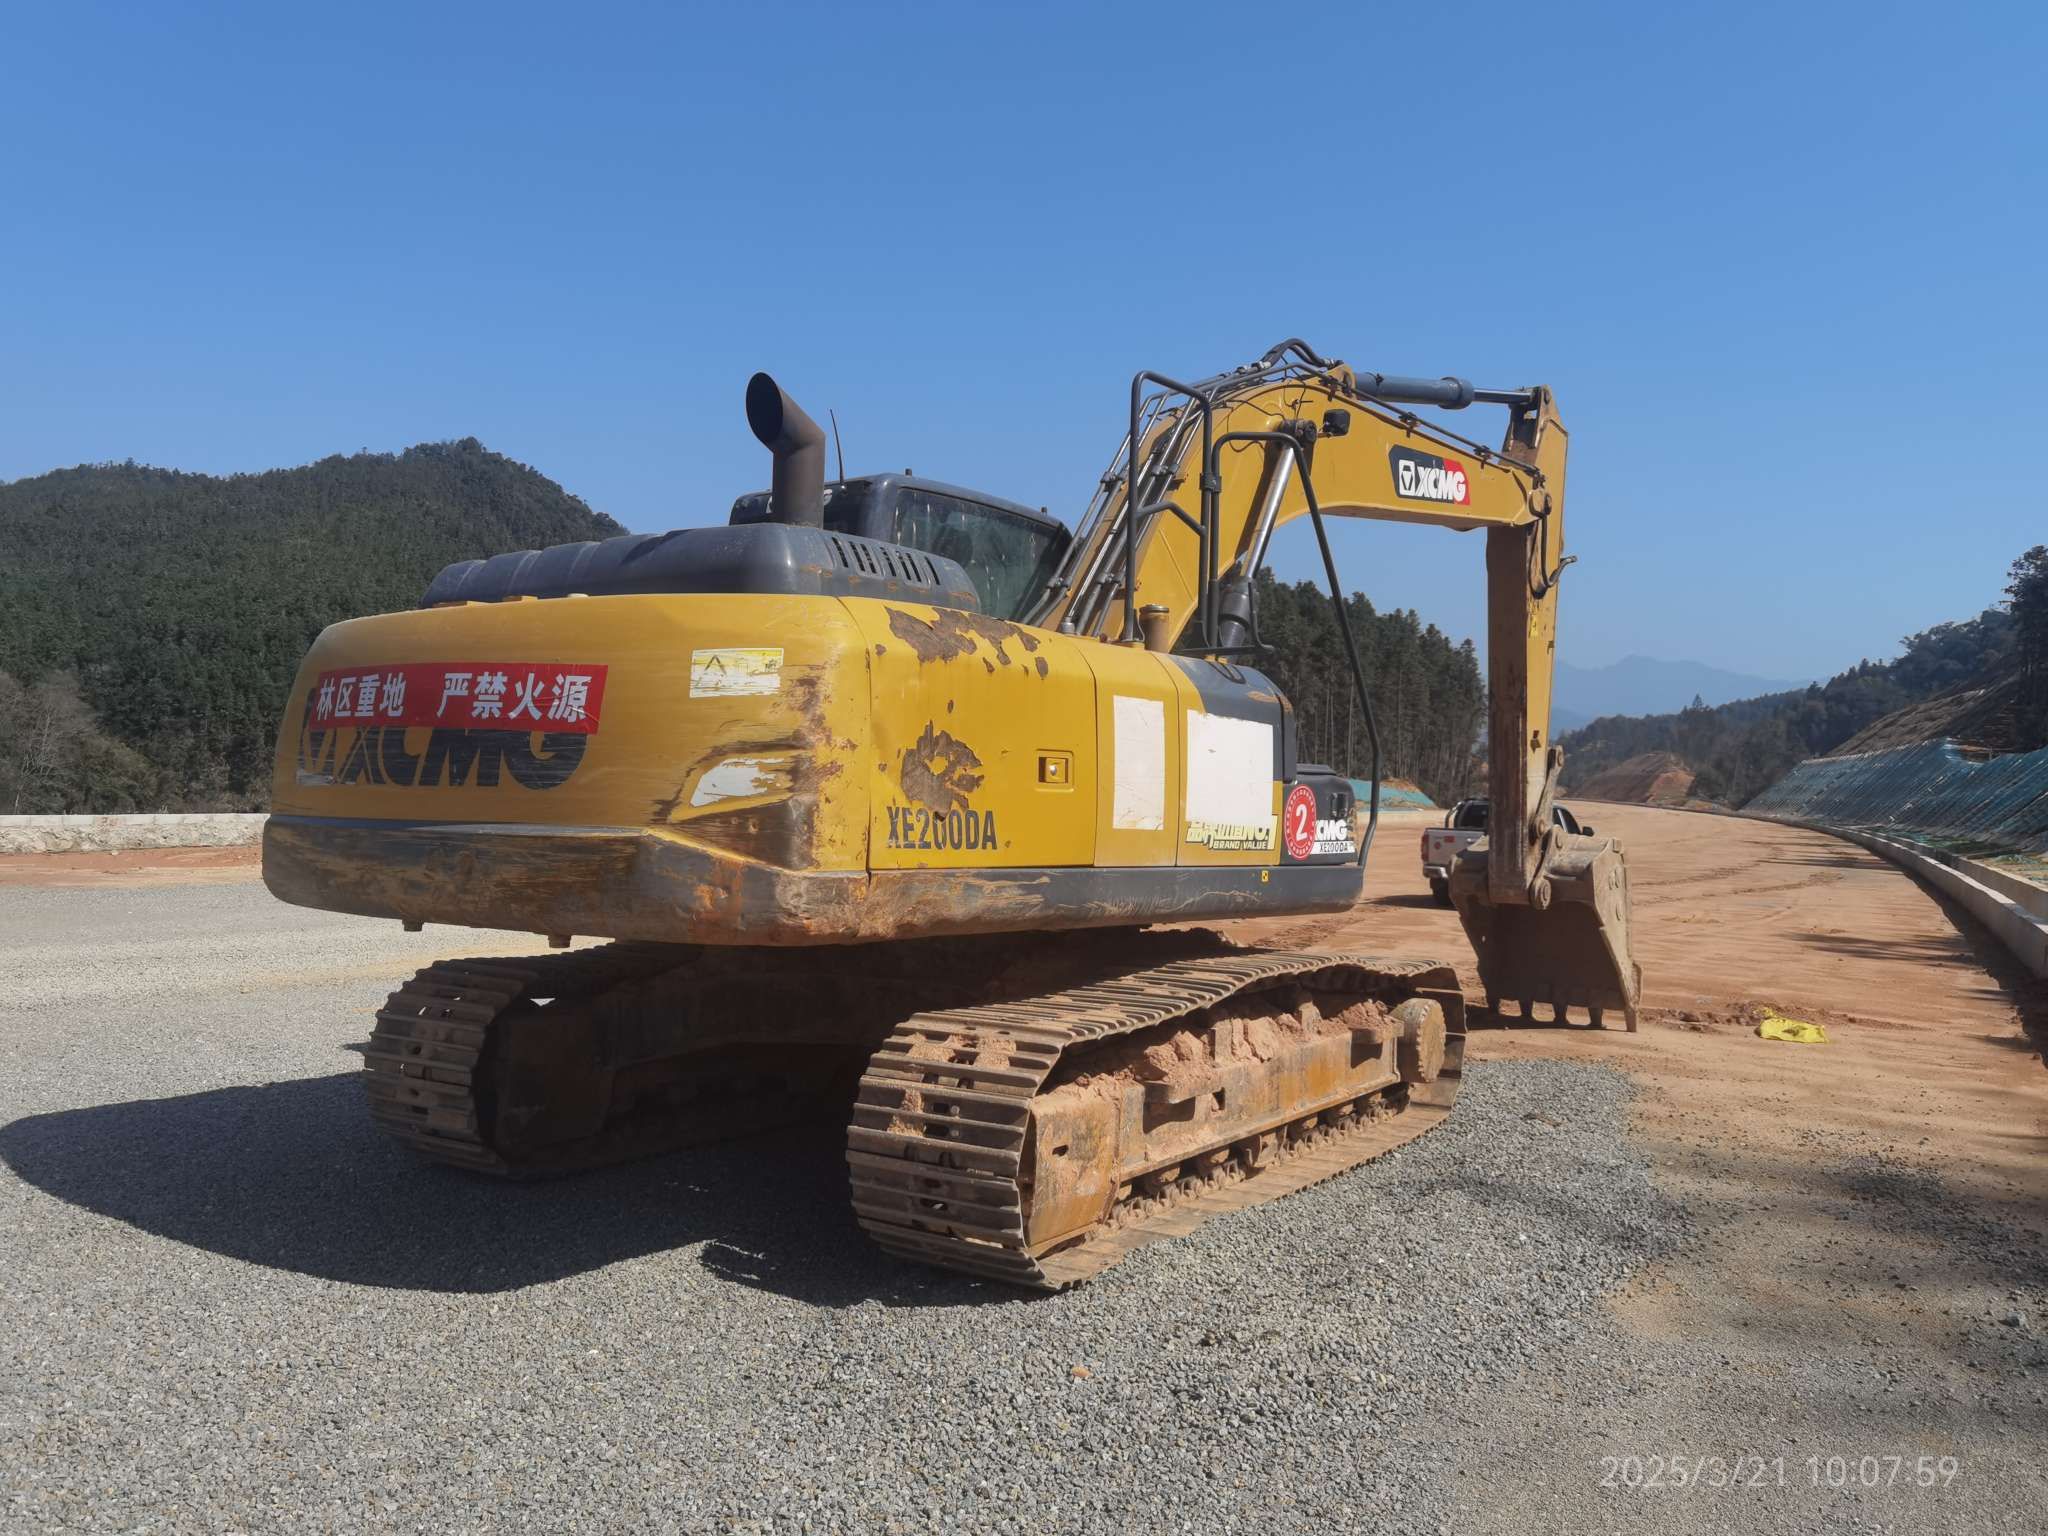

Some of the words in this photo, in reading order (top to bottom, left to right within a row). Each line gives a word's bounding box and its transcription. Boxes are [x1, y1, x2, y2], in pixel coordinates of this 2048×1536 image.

[1416, 465, 1466, 502] XCMG
[315, 671, 406, 721] 林区重地
[436, 671, 593, 723] 严禁火源
[886, 805, 998, 850] XE200DA
[1295, 803, 1308, 841] 2
[1314, 818, 1348, 841] CMG
[1213, 840, 1241, 850] BRAND
[1243, 840, 1268, 851] VALUE
[1319, 841, 1348, 853] XE200DA
